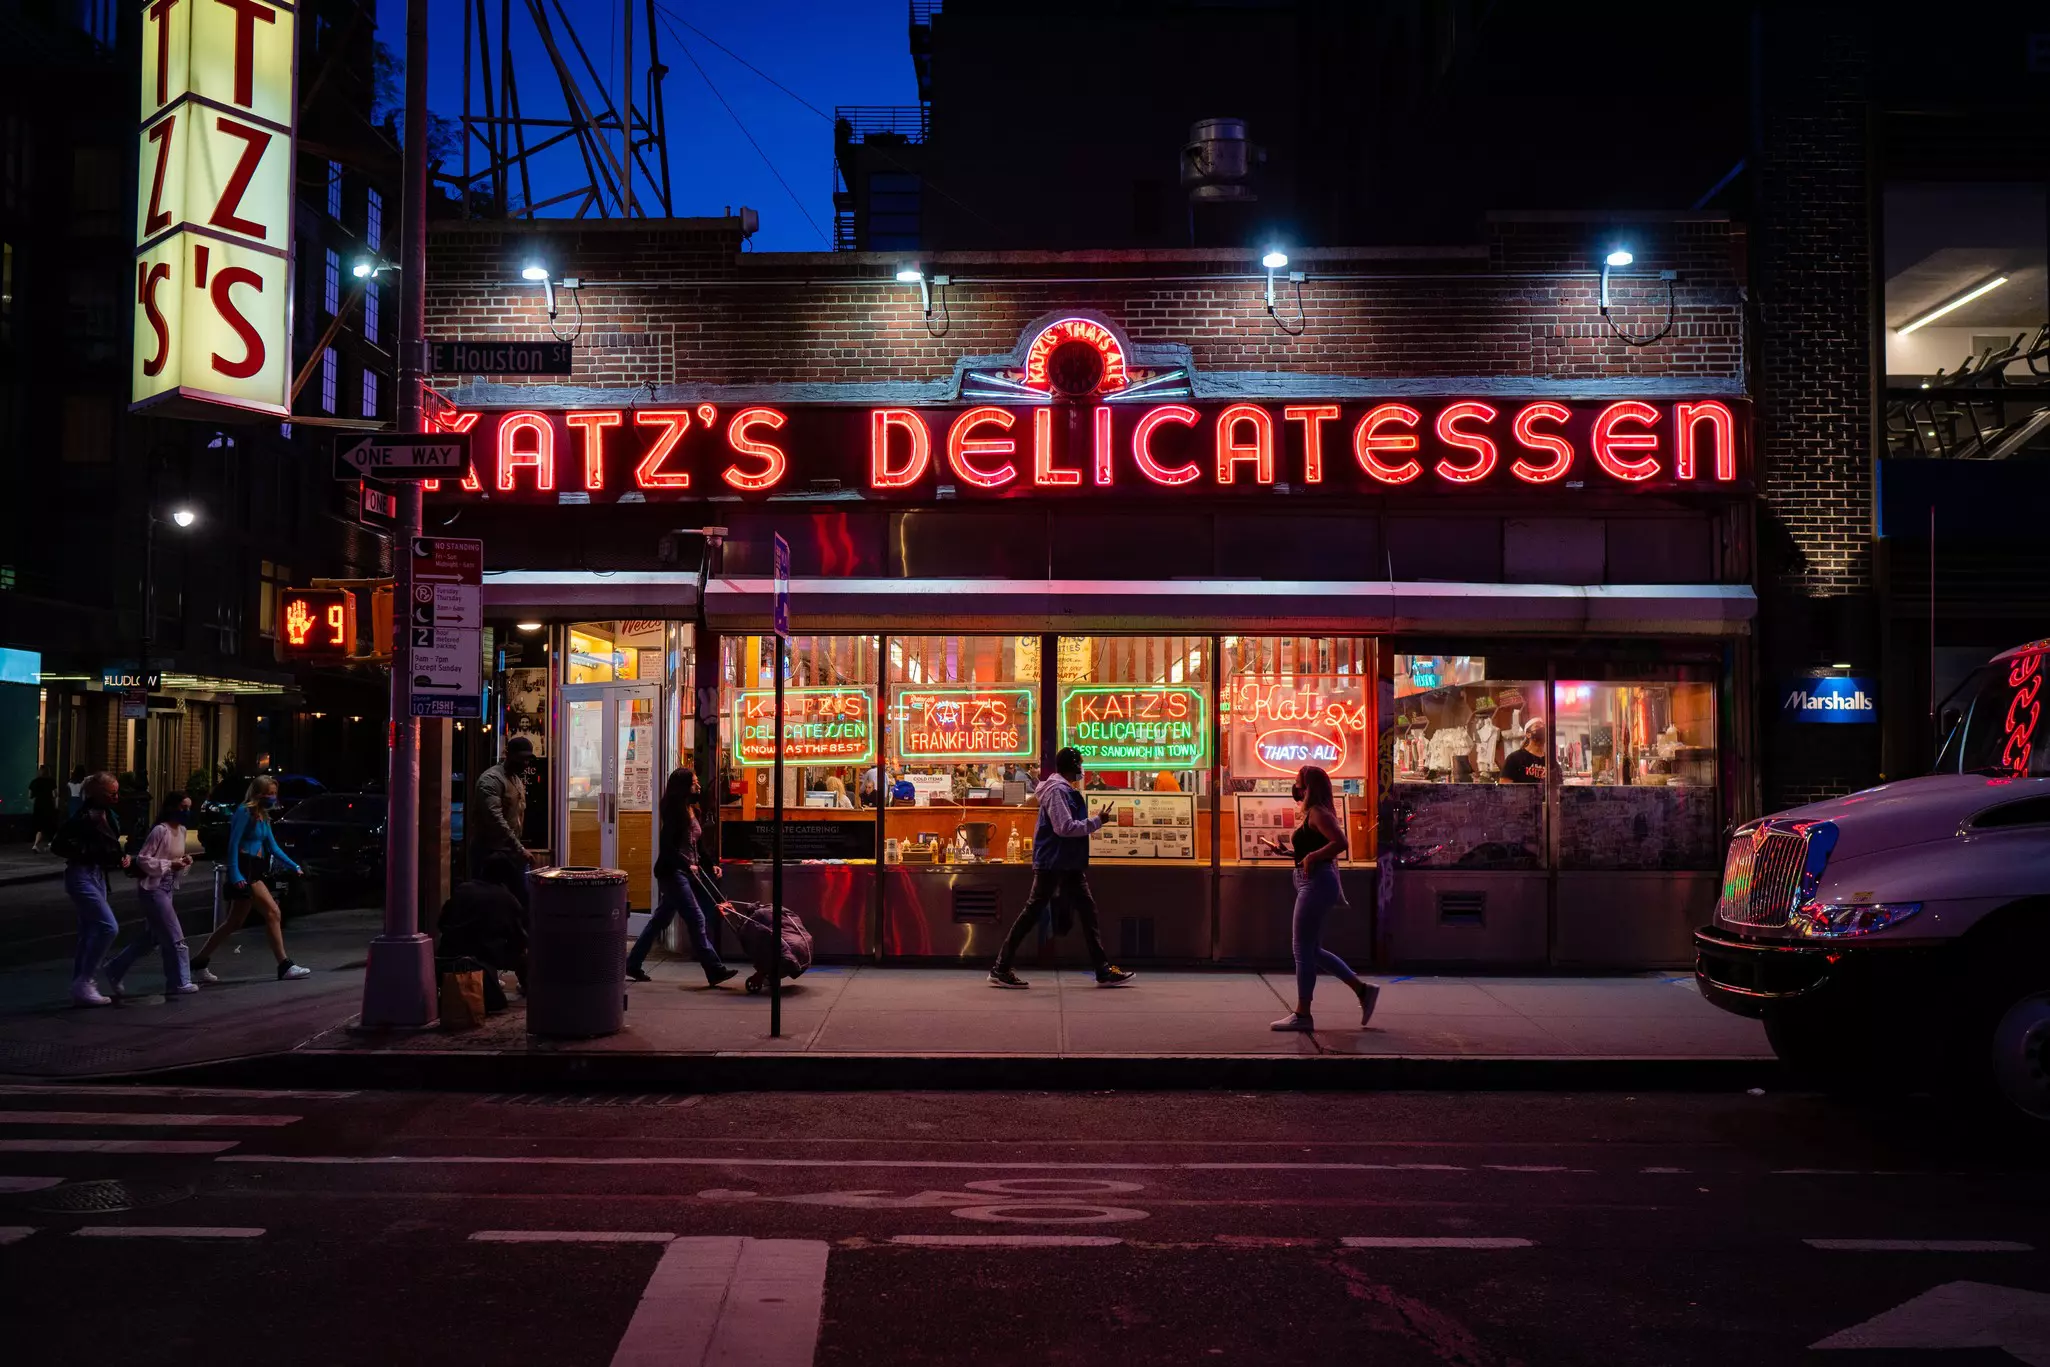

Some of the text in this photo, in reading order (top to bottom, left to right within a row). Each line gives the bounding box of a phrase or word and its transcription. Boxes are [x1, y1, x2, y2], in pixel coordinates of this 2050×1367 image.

[433, 344, 567, 371] E Houston St
[869, 400, 1738, 490] DELICATESSEN
[355, 447, 452, 466] ONE WAY
[370, 494, 388, 516] ONE
[435, 542, 480, 551] NO STANDING
[328, 605, 344, 644] 9
[417, 628, 429, 646] 2
[414, 664, 462, 673] Except Sunday
[435, 655, 449, 663] 7pm
[412, 702, 431, 715] 107
[1079, 690, 1187, 722] KATZ'S
[1783, 690, 1873, 711] Marshalls
[786, 745, 803, 754] AS
[829, 743, 861, 752] BEST
[910, 731, 1019, 751] FRANKFURTERS
[1100, 745, 1153, 758] SANDWICH
[1155, 745, 1164, 757] IN
[1166, 744, 1197, 757] TOWN
